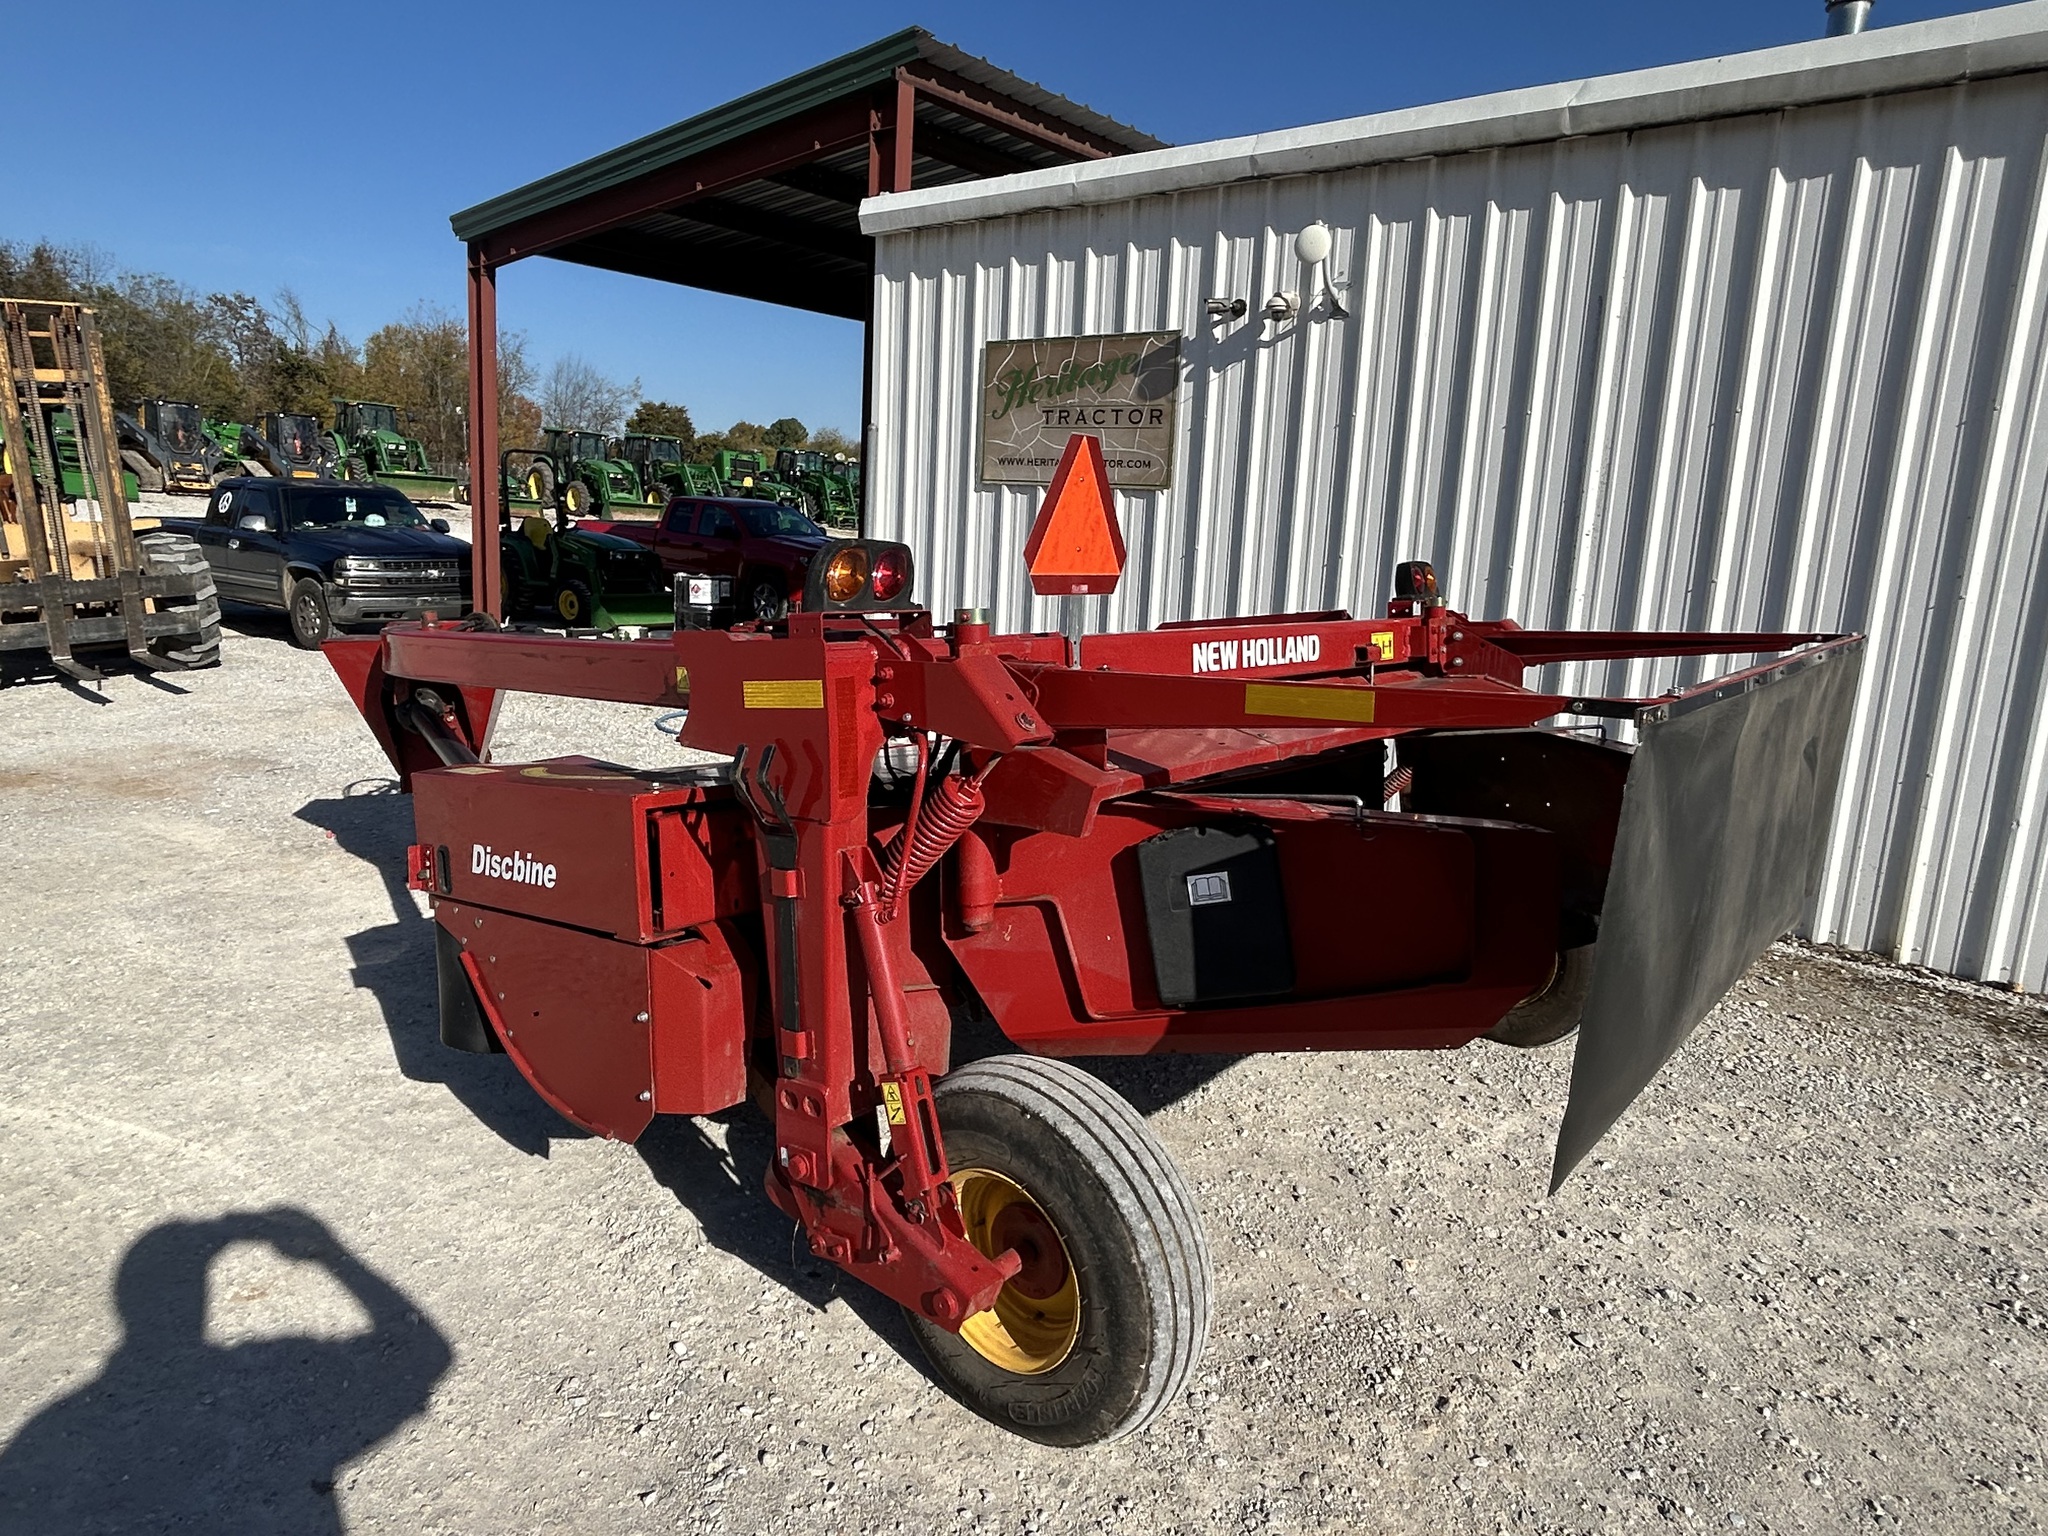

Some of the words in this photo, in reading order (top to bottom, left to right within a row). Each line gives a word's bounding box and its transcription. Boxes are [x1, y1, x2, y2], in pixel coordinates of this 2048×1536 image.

[992, 353, 1141, 419] Heritage
[1042, 408, 1164, 425] TRACTOR
[1192, 640, 1238, 674] NEW
[1242, 634, 1320, 668] HOLLAND
[471, 843, 557, 889] Discbine
